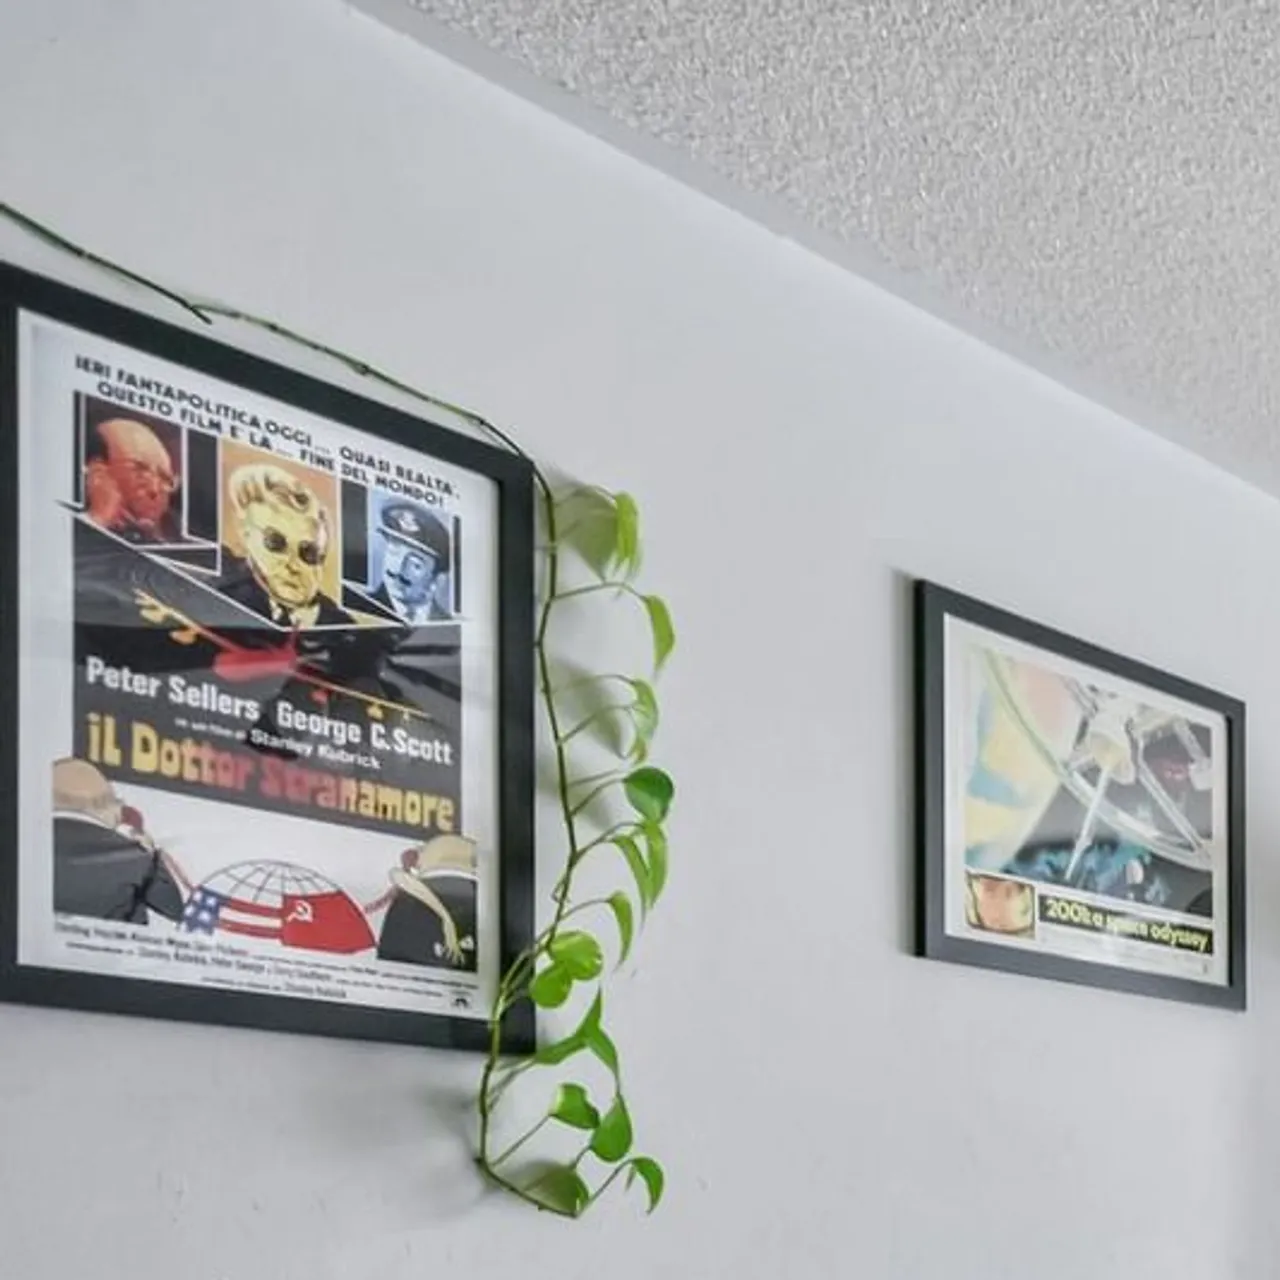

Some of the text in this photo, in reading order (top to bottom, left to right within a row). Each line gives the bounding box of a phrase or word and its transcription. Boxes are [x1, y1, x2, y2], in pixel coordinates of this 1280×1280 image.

[75, 355, 111, 379] IERI
[117, 369, 261, 429] FANTAPOLITICA
[339, 446, 391, 473] QUASI
[97, 381, 173, 417] QUESTO
[180, 408, 222, 434] FILM
[301, 450, 335, 472] FINE
[341, 464, 369, 484] DEL
[86, 655, 162, 698] Peter
[168, 674, 261, 721] Sellers
[276, 700, 362, 746] George
[131, 720, 255, 791] Dottor
[317, 743, 382, 770] Kubrick
